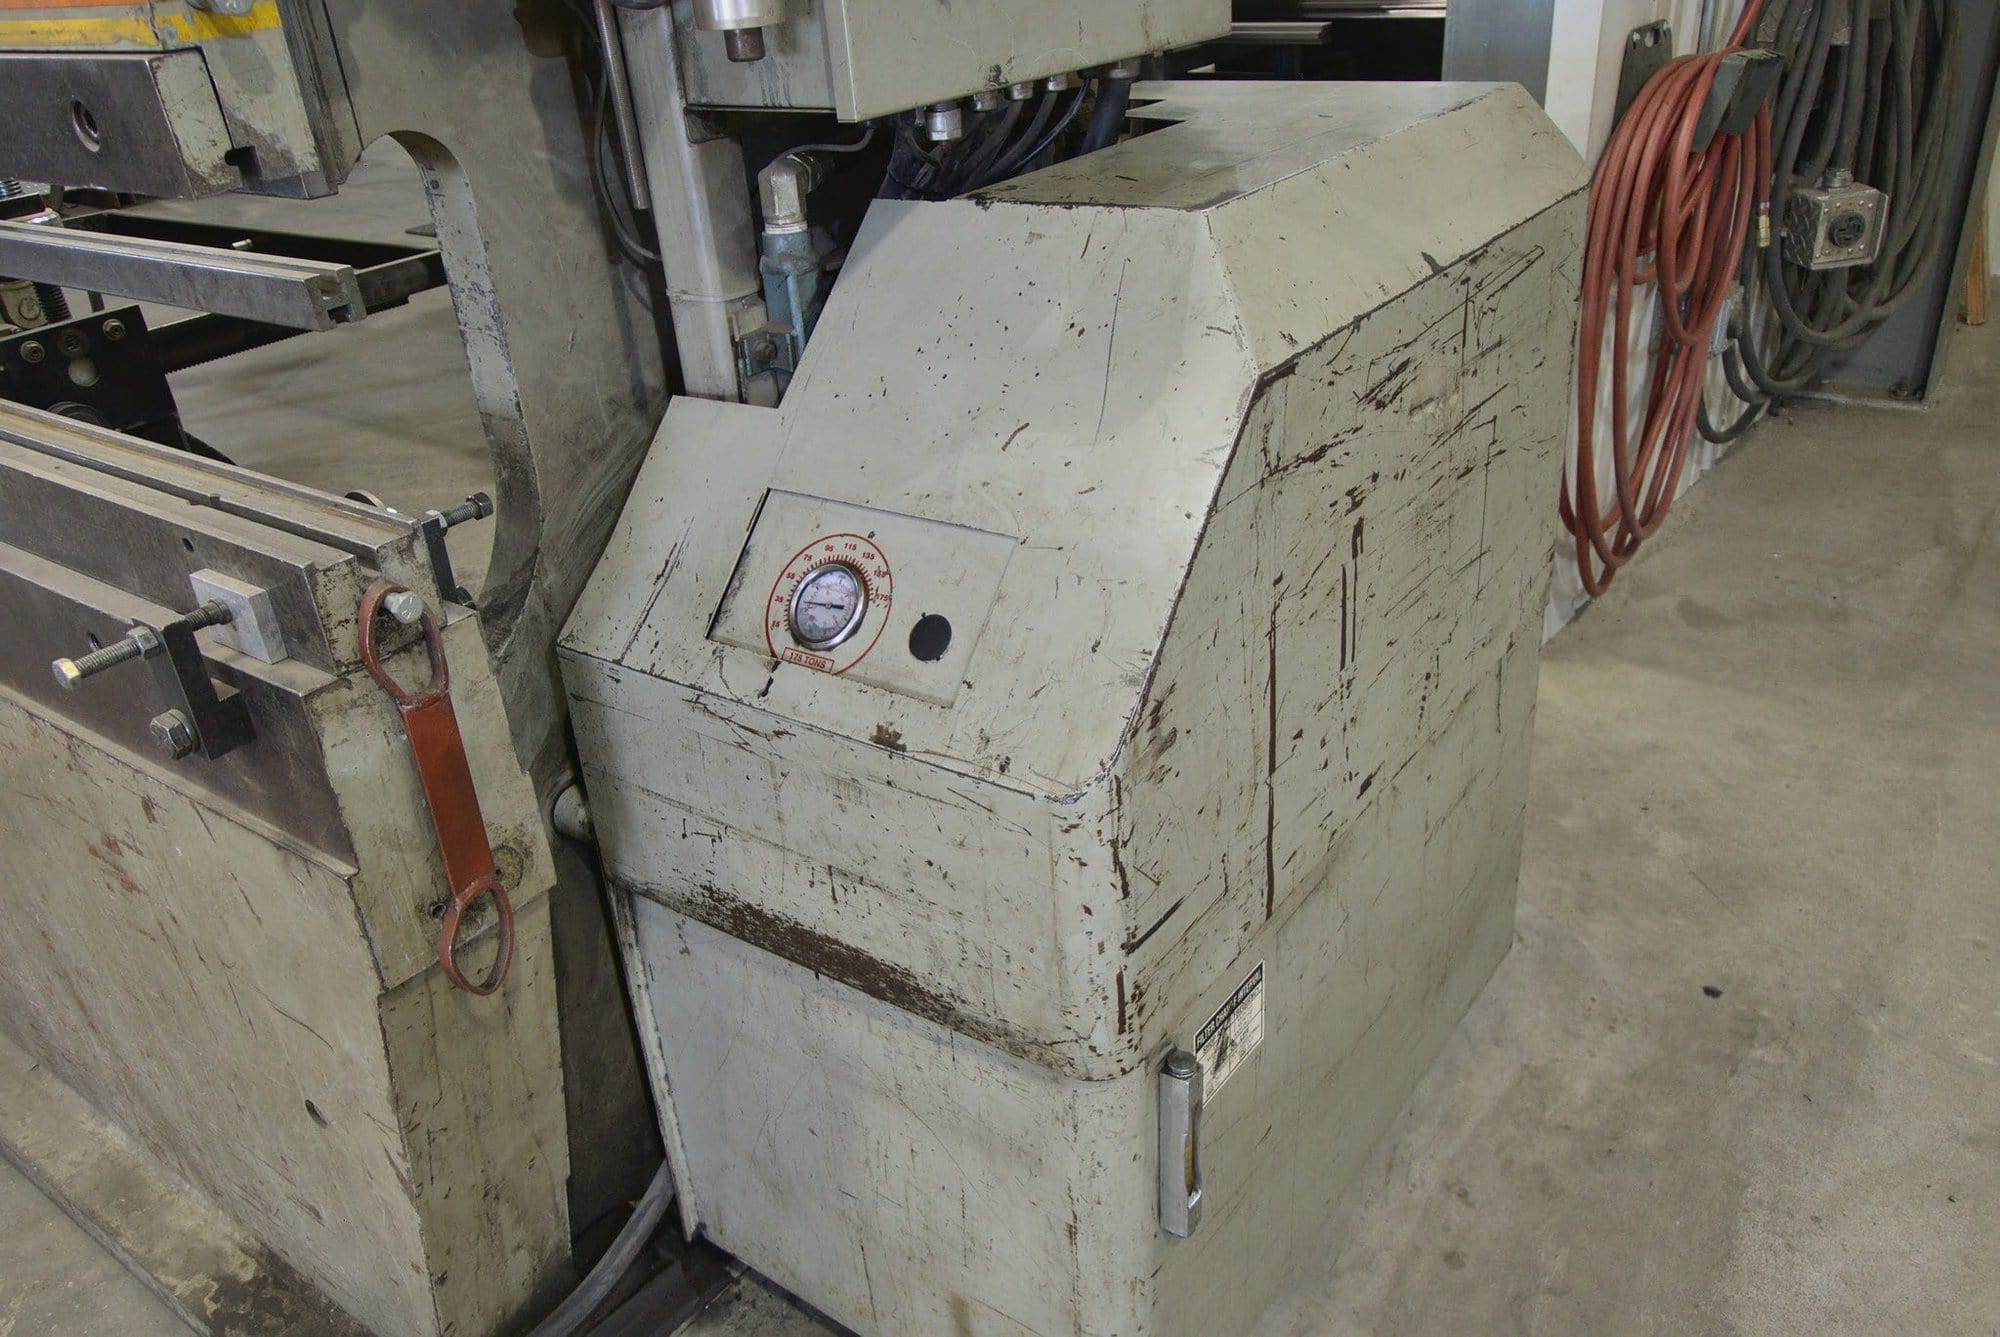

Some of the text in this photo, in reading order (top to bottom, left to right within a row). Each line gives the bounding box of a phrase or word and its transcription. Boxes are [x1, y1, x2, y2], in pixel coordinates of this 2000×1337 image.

[844, 543, 857, 551] 115
[804, 553, 813, 562] 75
[862, 552, 875, 560] 135
[774, 594, 783, 603] 35
[789, 652, 827, 669] 175 TONS
[1196, 1020, 1215, 1047] FILTER
